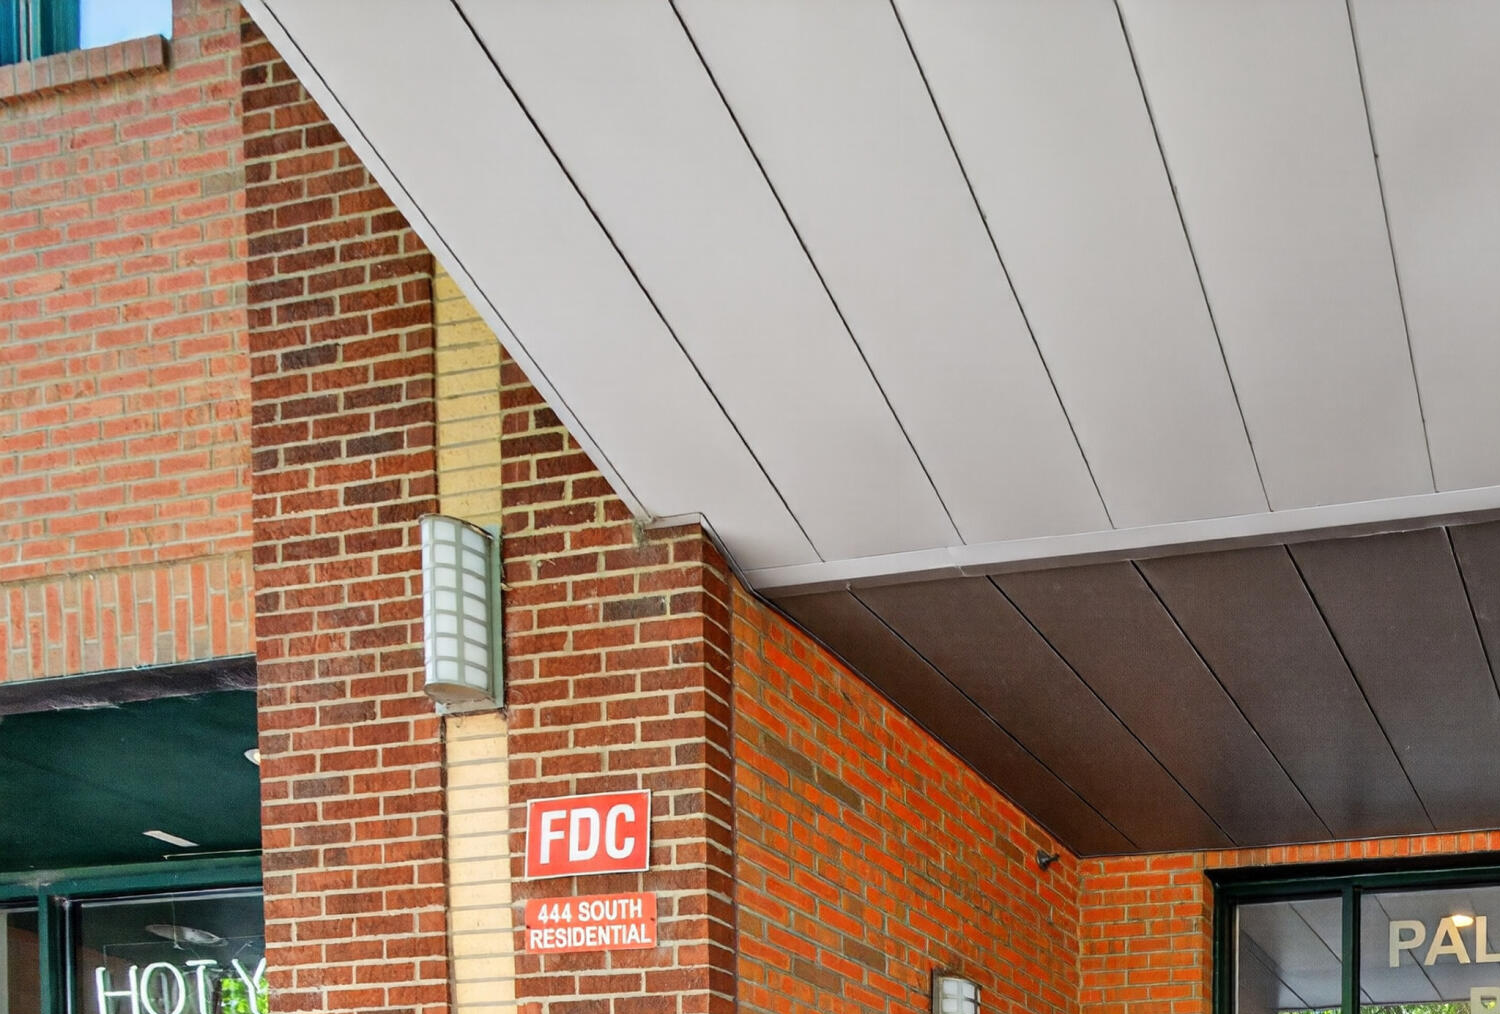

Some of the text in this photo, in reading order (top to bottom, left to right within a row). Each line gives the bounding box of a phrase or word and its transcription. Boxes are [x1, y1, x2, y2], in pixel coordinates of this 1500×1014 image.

[540, 803, 635, 865] FDC
[537, 898, 643, 924] 444 SOUTH
[530, 923, 652, 949] RESIDENTIAL
